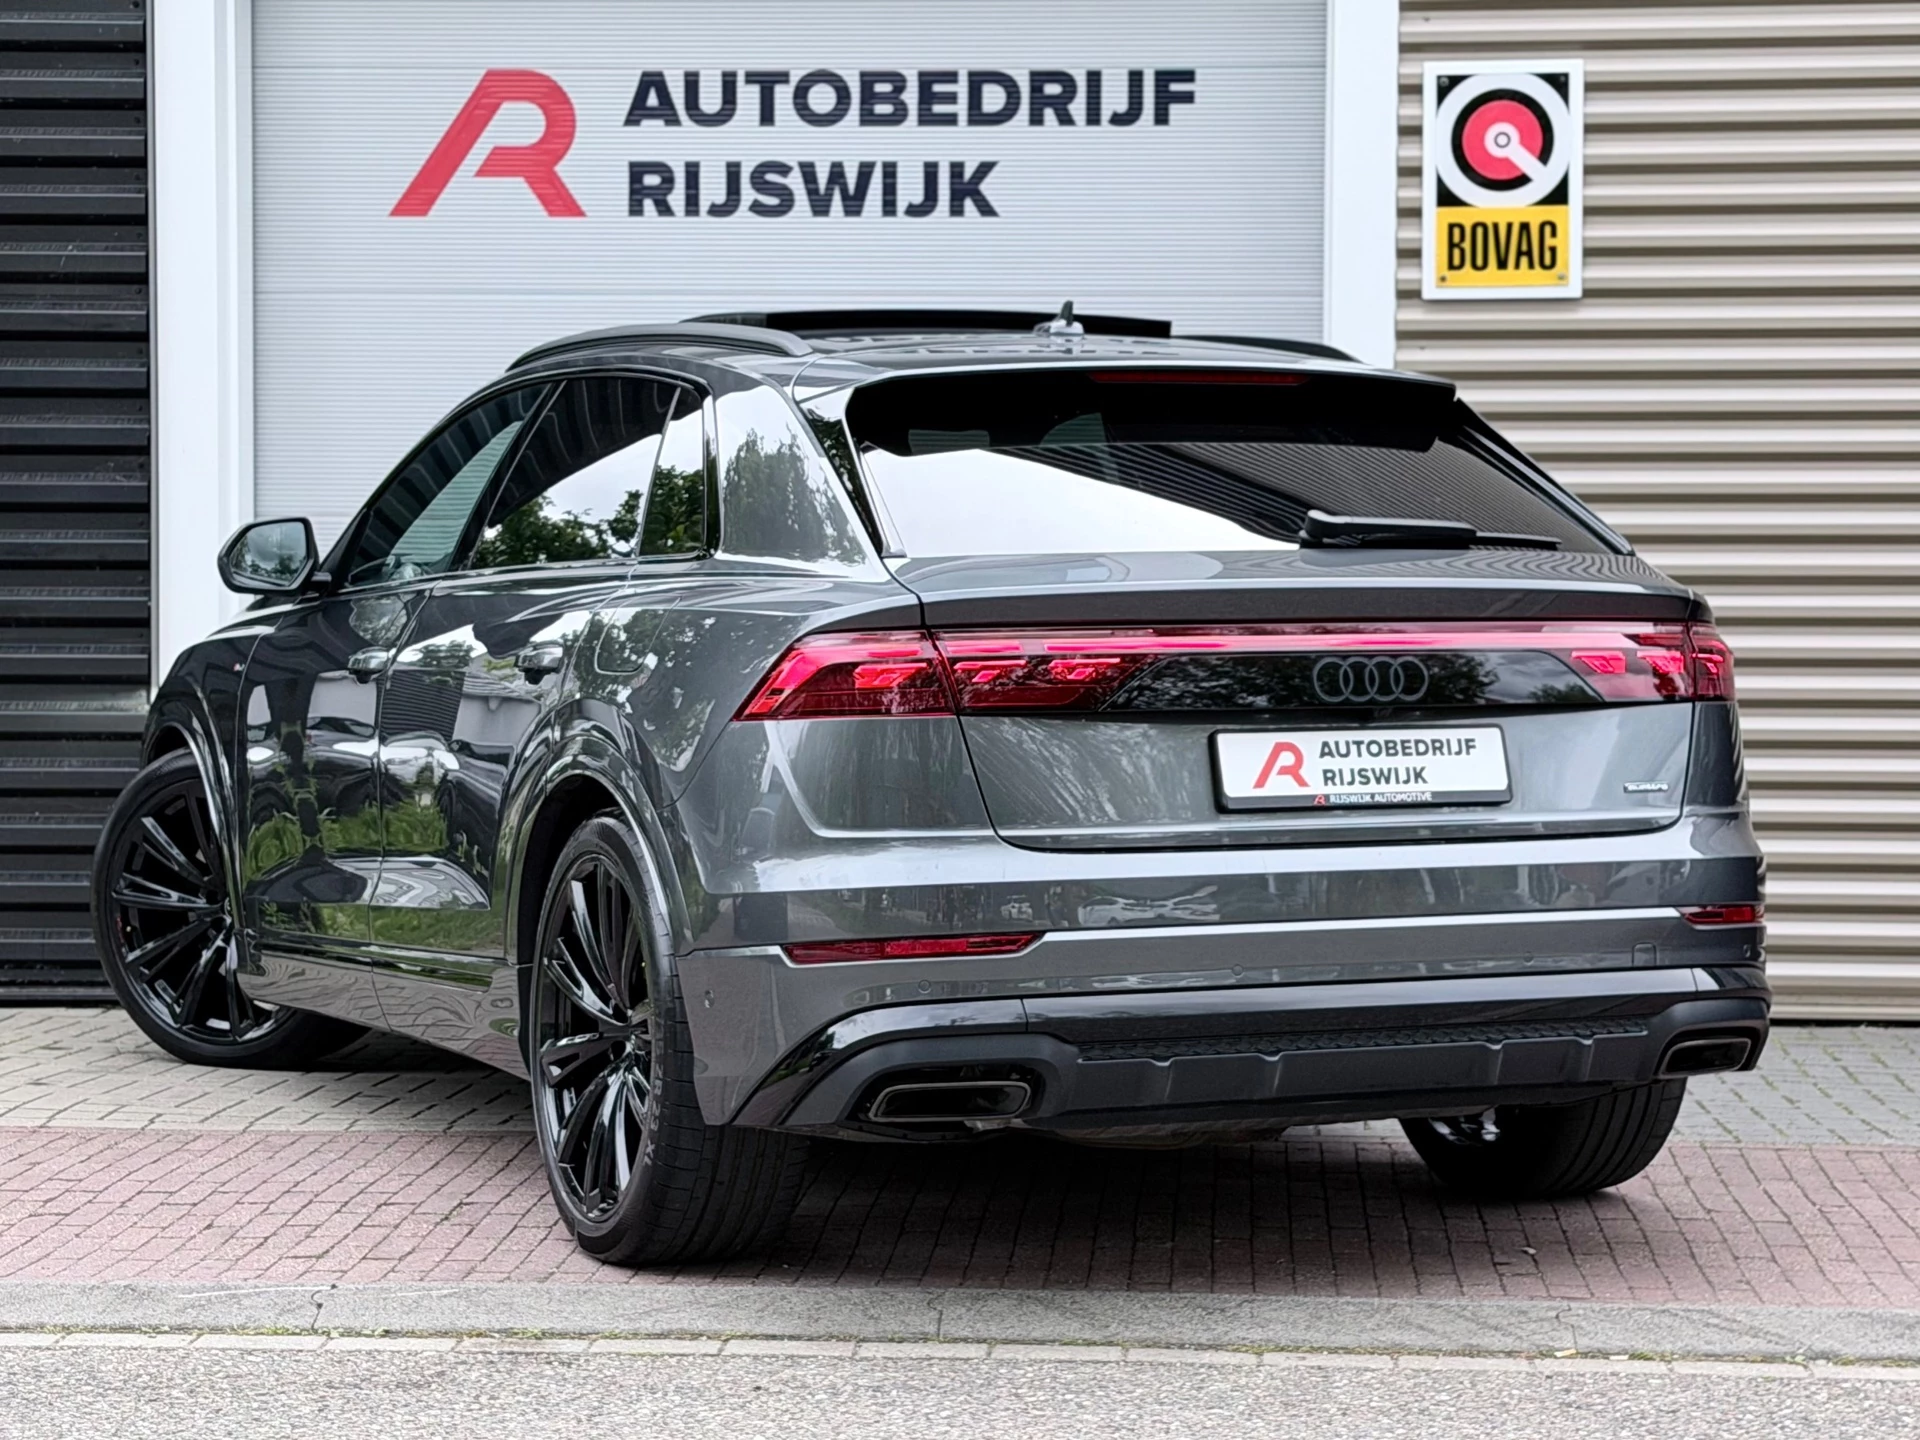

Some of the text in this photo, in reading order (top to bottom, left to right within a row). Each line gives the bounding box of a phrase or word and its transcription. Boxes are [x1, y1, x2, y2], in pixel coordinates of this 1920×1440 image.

[623, 69, 1196, 127] AUTOBEDRIJF
[628, 161, 1000, 218] RIJSWIJK
[1447, 220, 1558, 271] BOVAG
[1319, 738, 1477, 759] AUTOBEDRIJF
[1322, 766, 1428, 787] RIJSWIJK
[1329, 793, 1372, 804] RIJSWIJK
[1374, 791, 1432, 803] AUTOMOTIVE
[642, 1138, 655, 1166] XL
